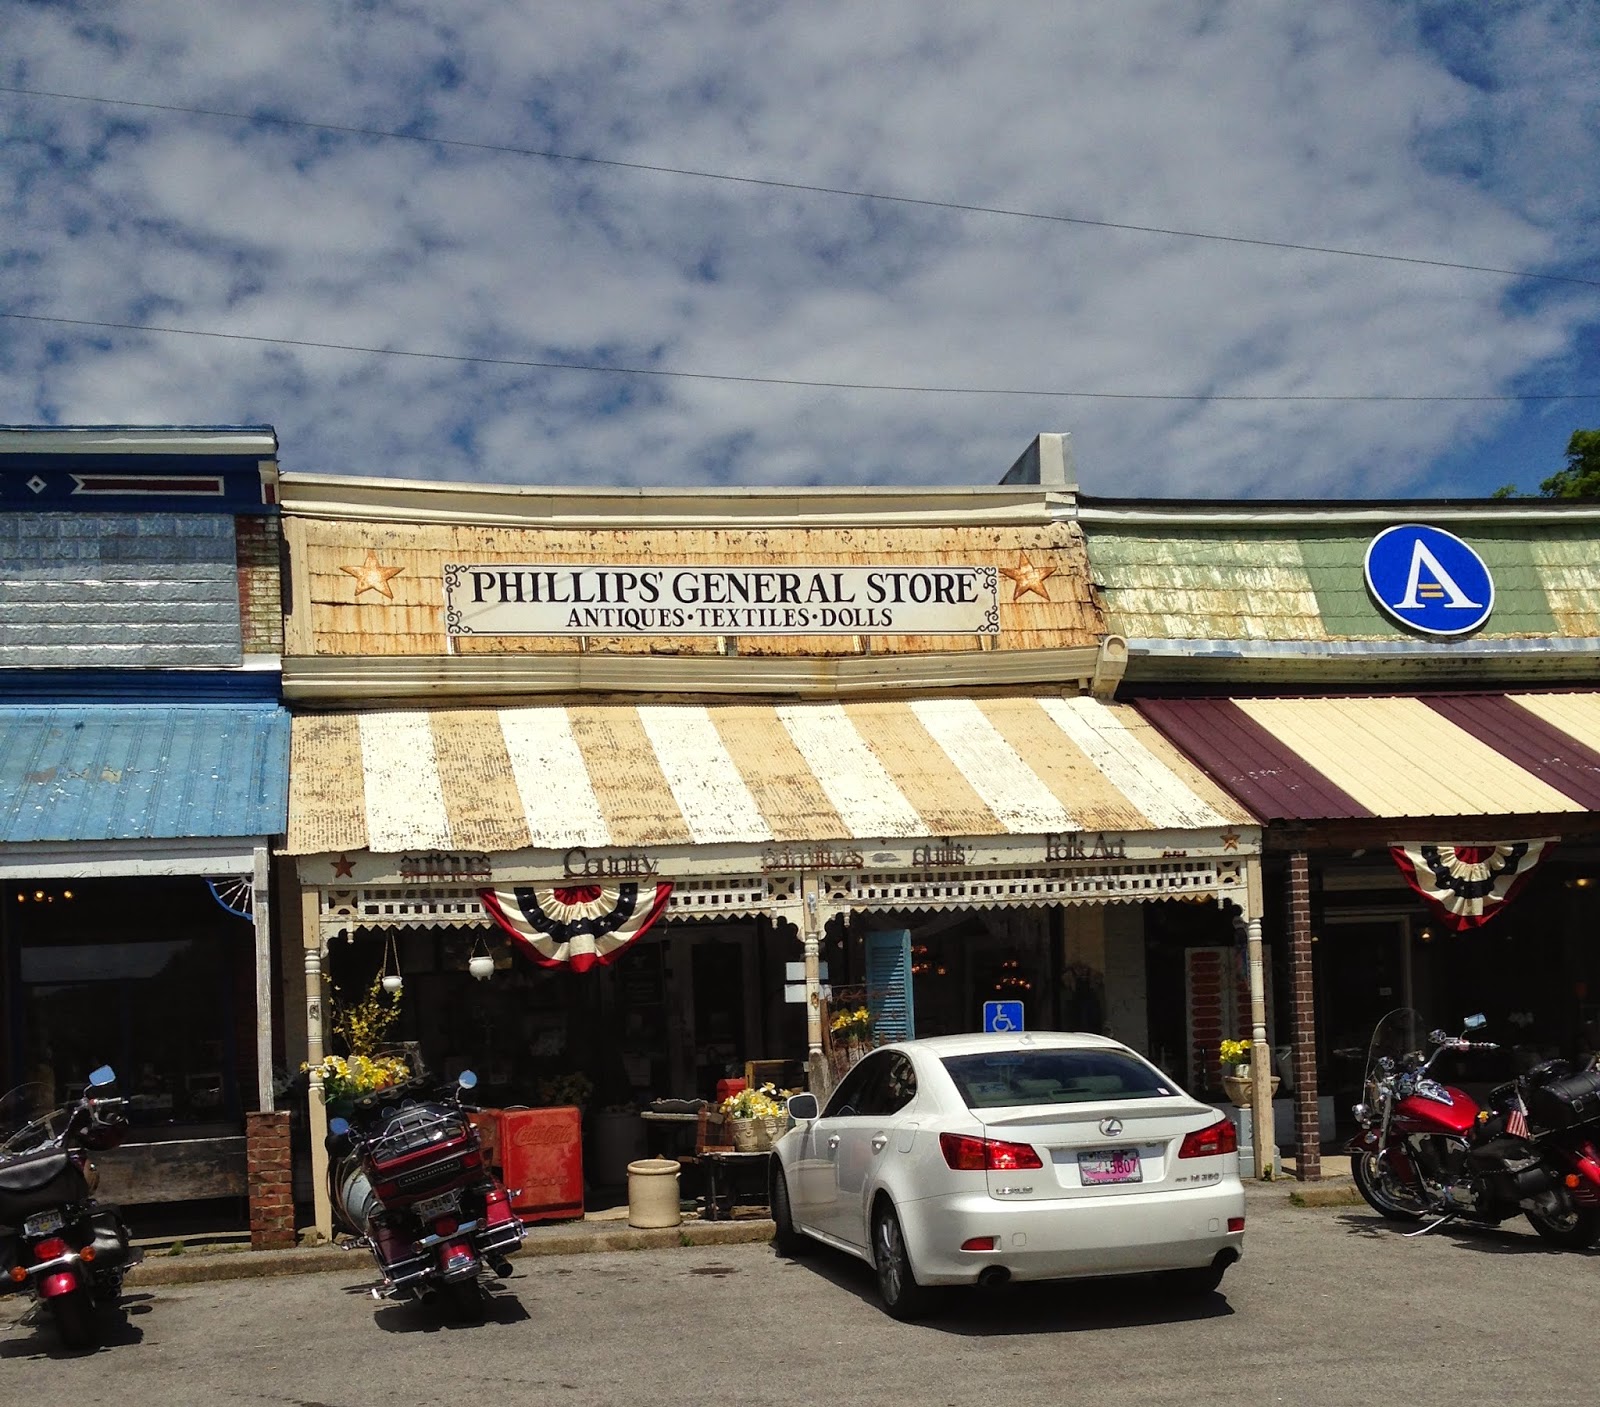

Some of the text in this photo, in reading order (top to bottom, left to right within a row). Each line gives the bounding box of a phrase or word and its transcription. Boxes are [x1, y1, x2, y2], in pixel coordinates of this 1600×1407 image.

[469, 571, 979, 605] PHILLIPS' GENERAL STORE
[1392, 538, 1483, 608] A
[565, 607, 894, 630] ANTIQUES TEXTILES DOLLS
